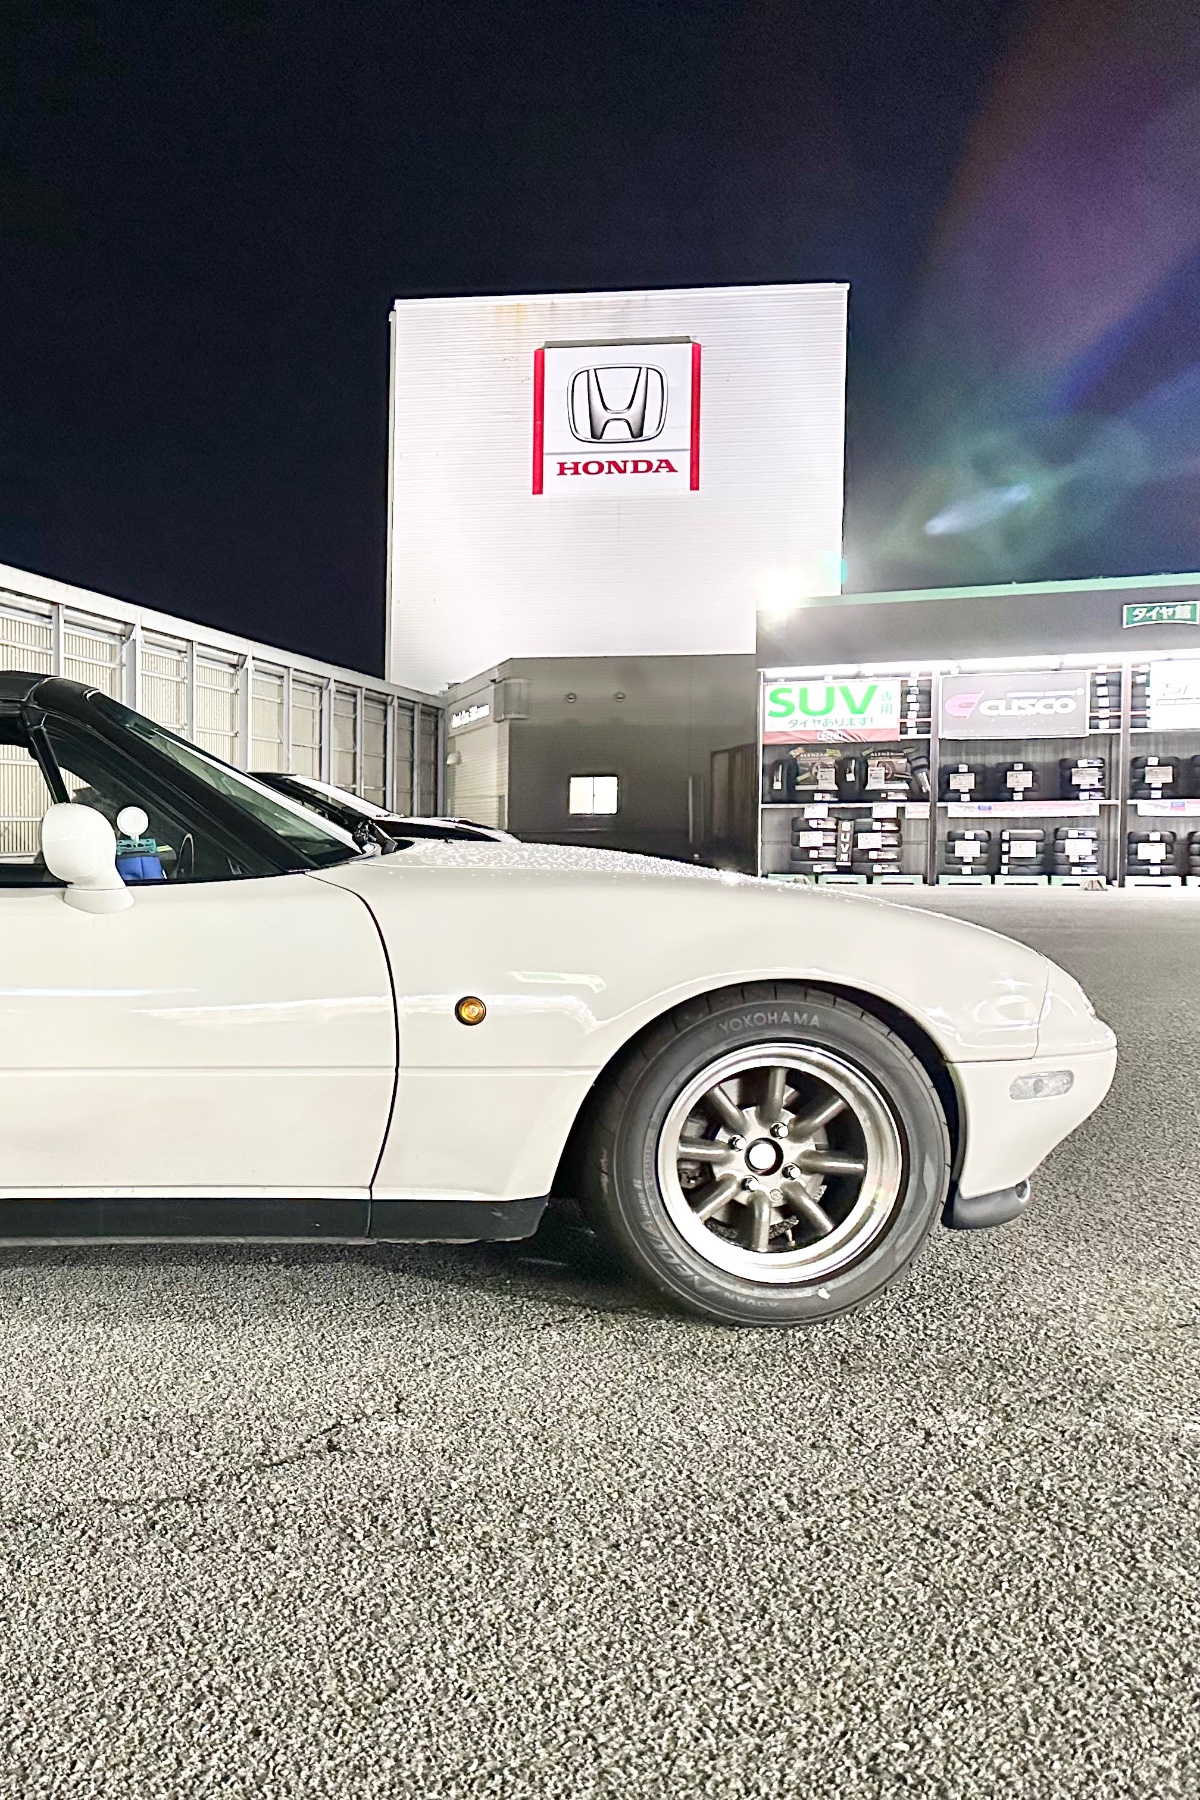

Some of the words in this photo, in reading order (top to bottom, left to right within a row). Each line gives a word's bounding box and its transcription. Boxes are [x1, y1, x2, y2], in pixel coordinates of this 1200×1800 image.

[556, 459, 678, 476] HONDA
[767, 684, 879, 718] SUV
[718, 1011, 821, 1035] YOKOHAMA
[723, 1291, 780, 1308] ADVAN
